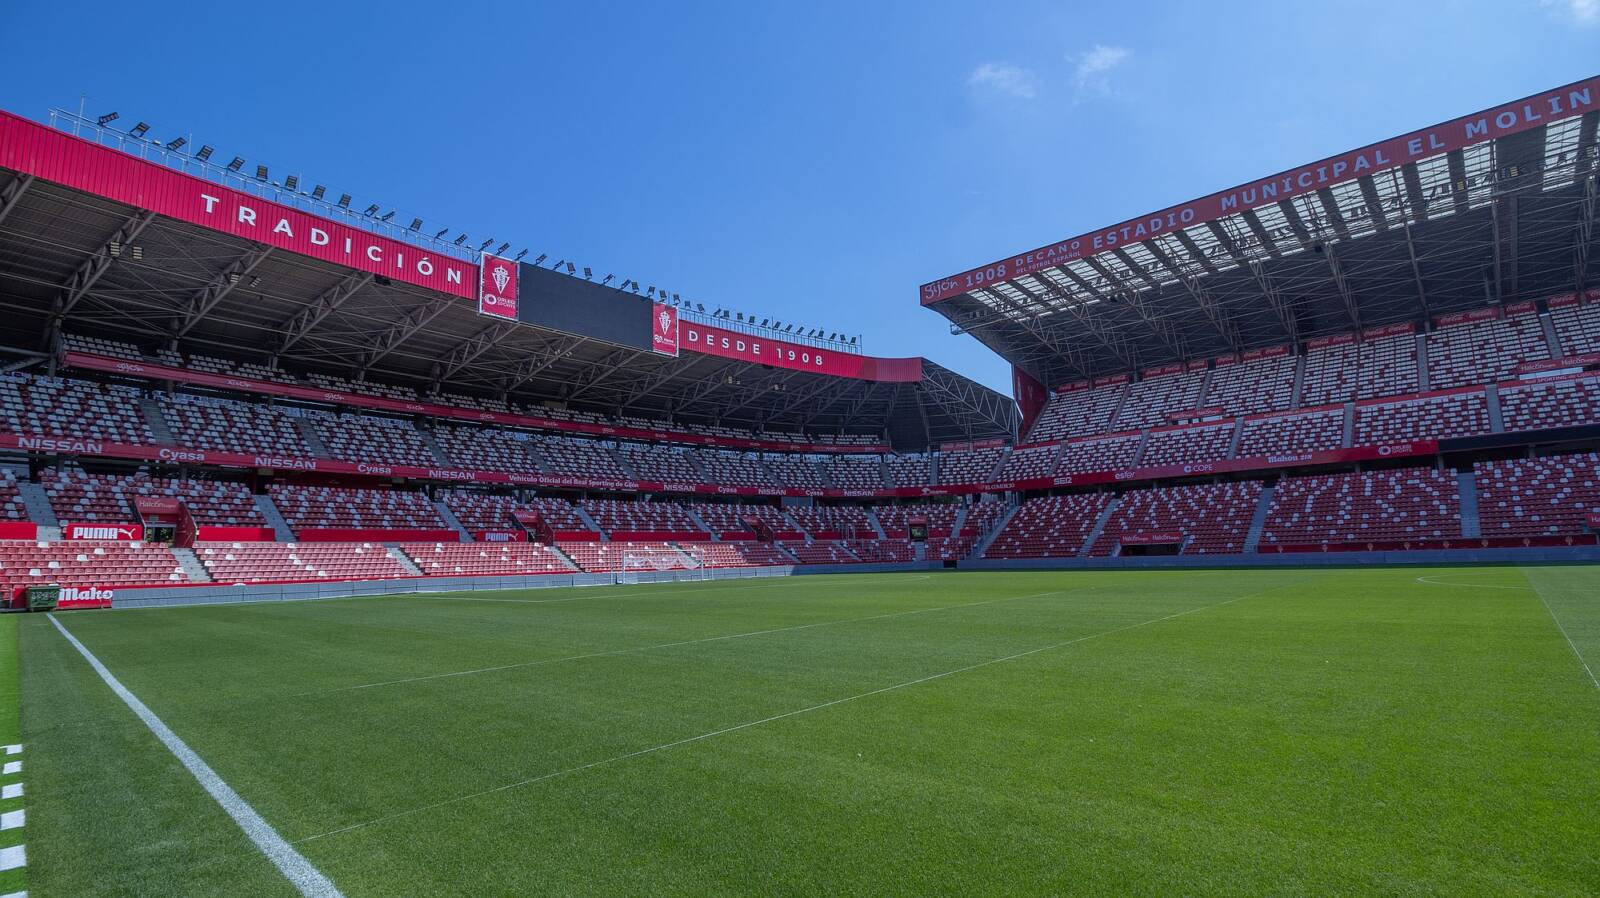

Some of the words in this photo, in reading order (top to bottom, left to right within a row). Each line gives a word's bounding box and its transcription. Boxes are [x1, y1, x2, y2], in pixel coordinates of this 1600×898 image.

[1093, 208, 1195, 250] ESTADIO
[1221, 149, 1391, 211] MUNICIPAL
[1407, 133, 1446, 156] EL
[1465, 87, 1592, 139] MOLIN
[201, 193, 462, 284] TRADICIÓN
[1015, 241, 1081, 267] DECANO
[965, 264, 1006, 288] 1908
[688, 330, 761, 355] DESDE
[776, 348, 823, 366] 1908
[18, 437, 102, 453] NISSAN
[159, 448, 205, 461] Cyasa
[255, 457, 317, 470] NISSAN
[357, 464, 392, 475] Cyasa
[1193, 464, 1213, 472] COPE
[429, 469, 476, 480] NISSAN
[588, 480, 615, 488] Sporting
[1054, 477, 1072, 485] SER
[663, 484, 696, 492] NISSAN
[758, 488, 787, 496] NISSAN
[73, 527, 118, 539] PUMA
[485, 532, 509, 541] PUMA
